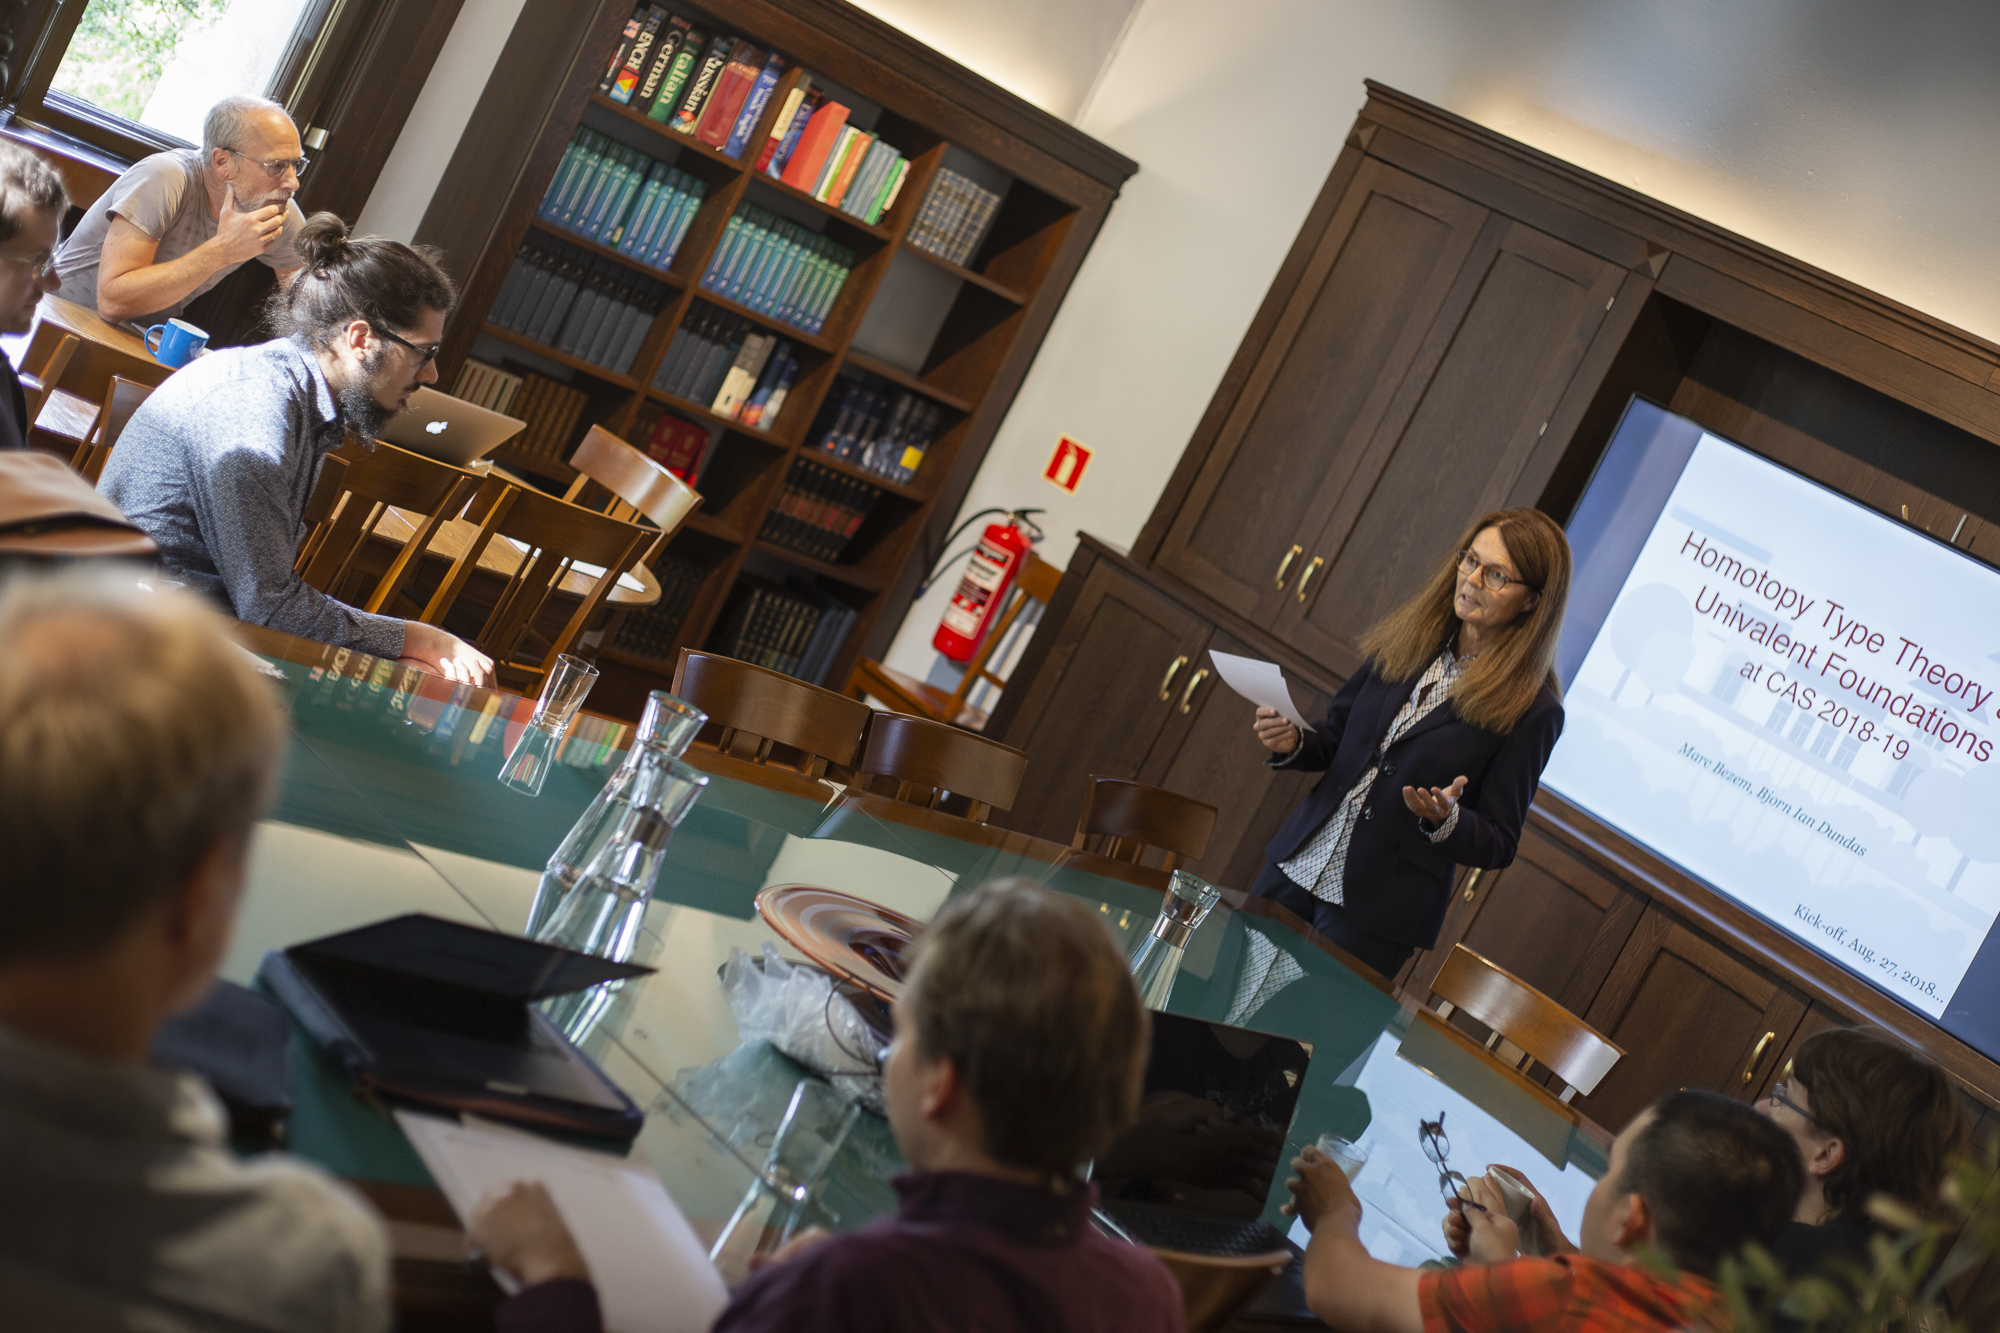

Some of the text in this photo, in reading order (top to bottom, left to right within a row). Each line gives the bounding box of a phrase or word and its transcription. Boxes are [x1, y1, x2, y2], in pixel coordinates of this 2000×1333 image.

[627, 16, 661, 70] FRENCH
[640, 30, 684, 99] German
[660, 44, 697, 105] Italian
[684, 49, 727, 112] Russian
[1680, 530, 1994, 713] Homotopy Type Theory
[1695, 585, 1994, 762] Univalent Foundations
[1739, 661, 1910, 761] at CAS 2018-19
[1678, 741, 1712, 769] Marc
[1711, 760, 1753, 797] Bezem,
[1792, 807, 1816, 829] Ian
[1816, 820, 1868, 857] Dundas
[1793, 903, 1944, 1004] Kick-off, Aug. 27, 2018...
